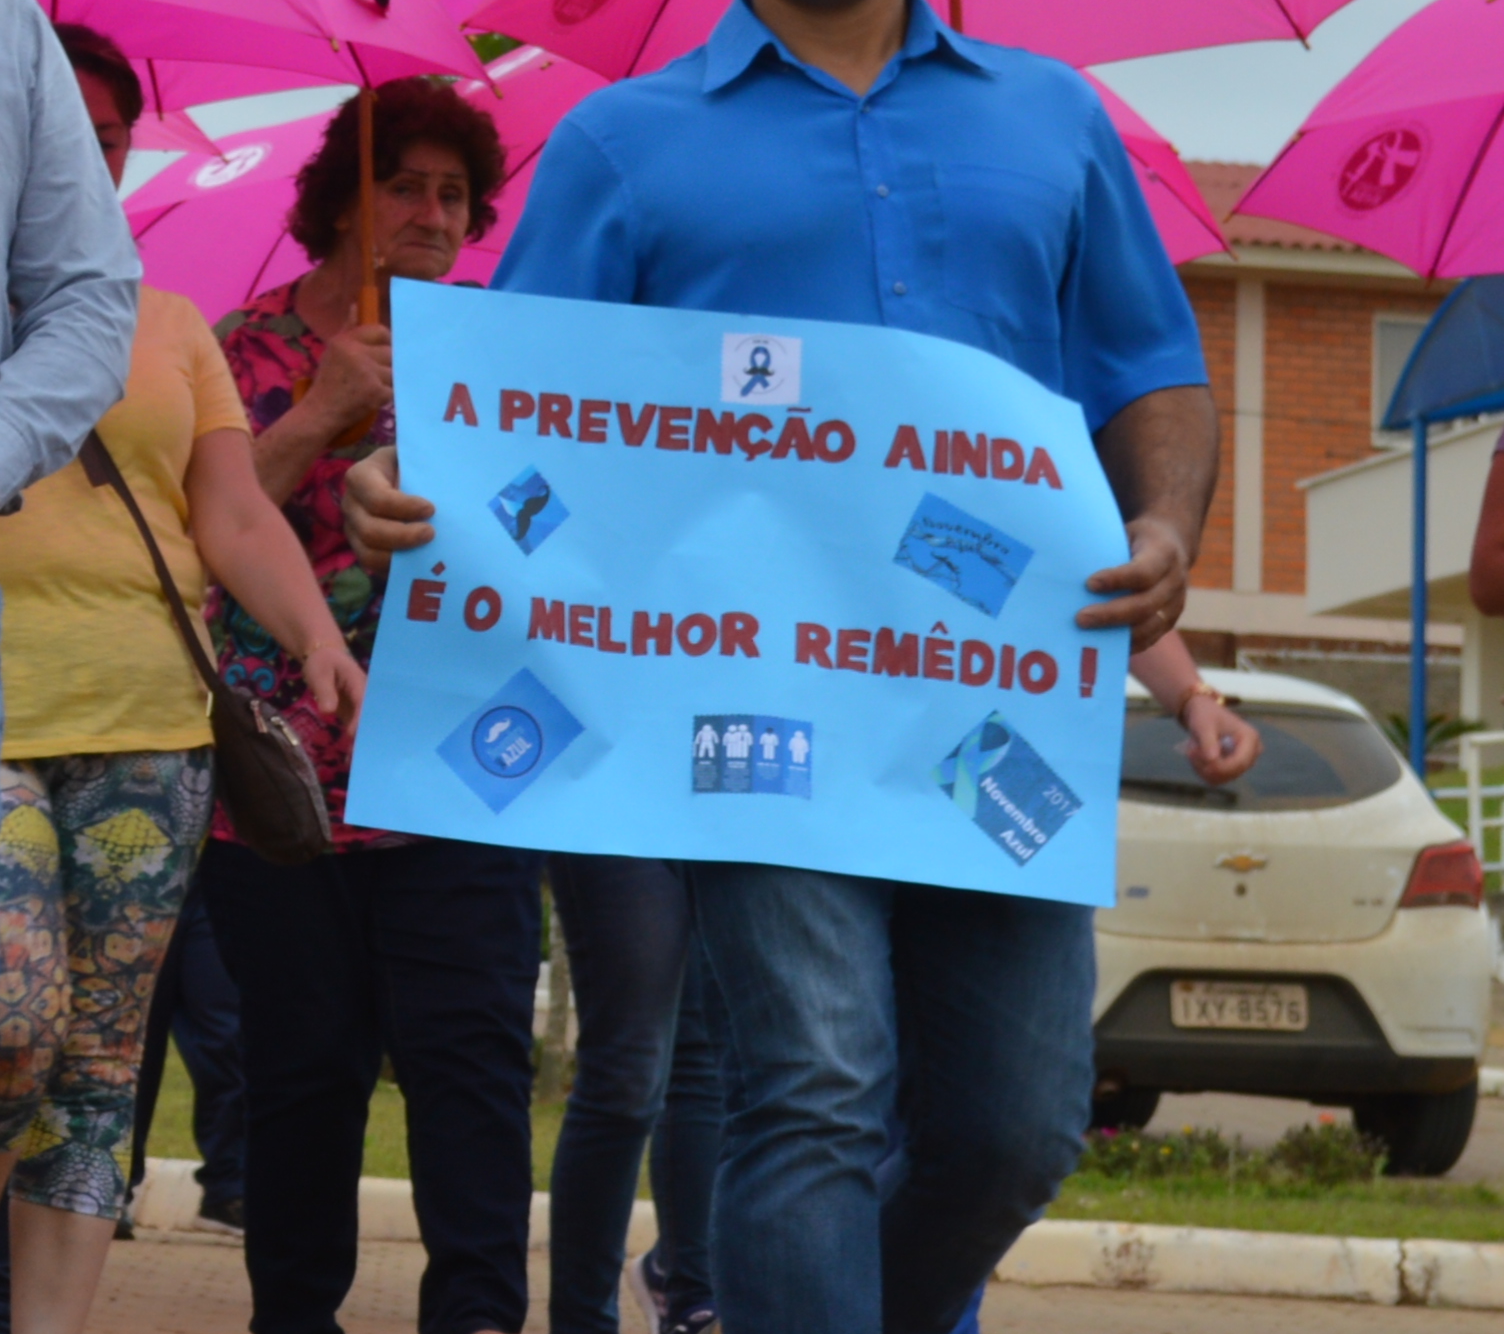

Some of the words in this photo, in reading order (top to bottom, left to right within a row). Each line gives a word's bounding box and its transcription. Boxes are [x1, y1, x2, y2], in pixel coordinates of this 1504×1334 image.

[443, 383, 479, 427] A
[499, 389, 857, 464] PREVENÇÃO
[884, 424, 1063, 490] AINDA
[406, 561, 446, 623] É
[464, 586, 503, 632] O
[529, 597, 760, 659] MELHOR
[795, 621, 1059, 695] REMÊDIO
[501, 737, 532, 768] AZUL
[980, 776, 1047, 844] Novembro
[999, 828, 1034, 860] Azul
